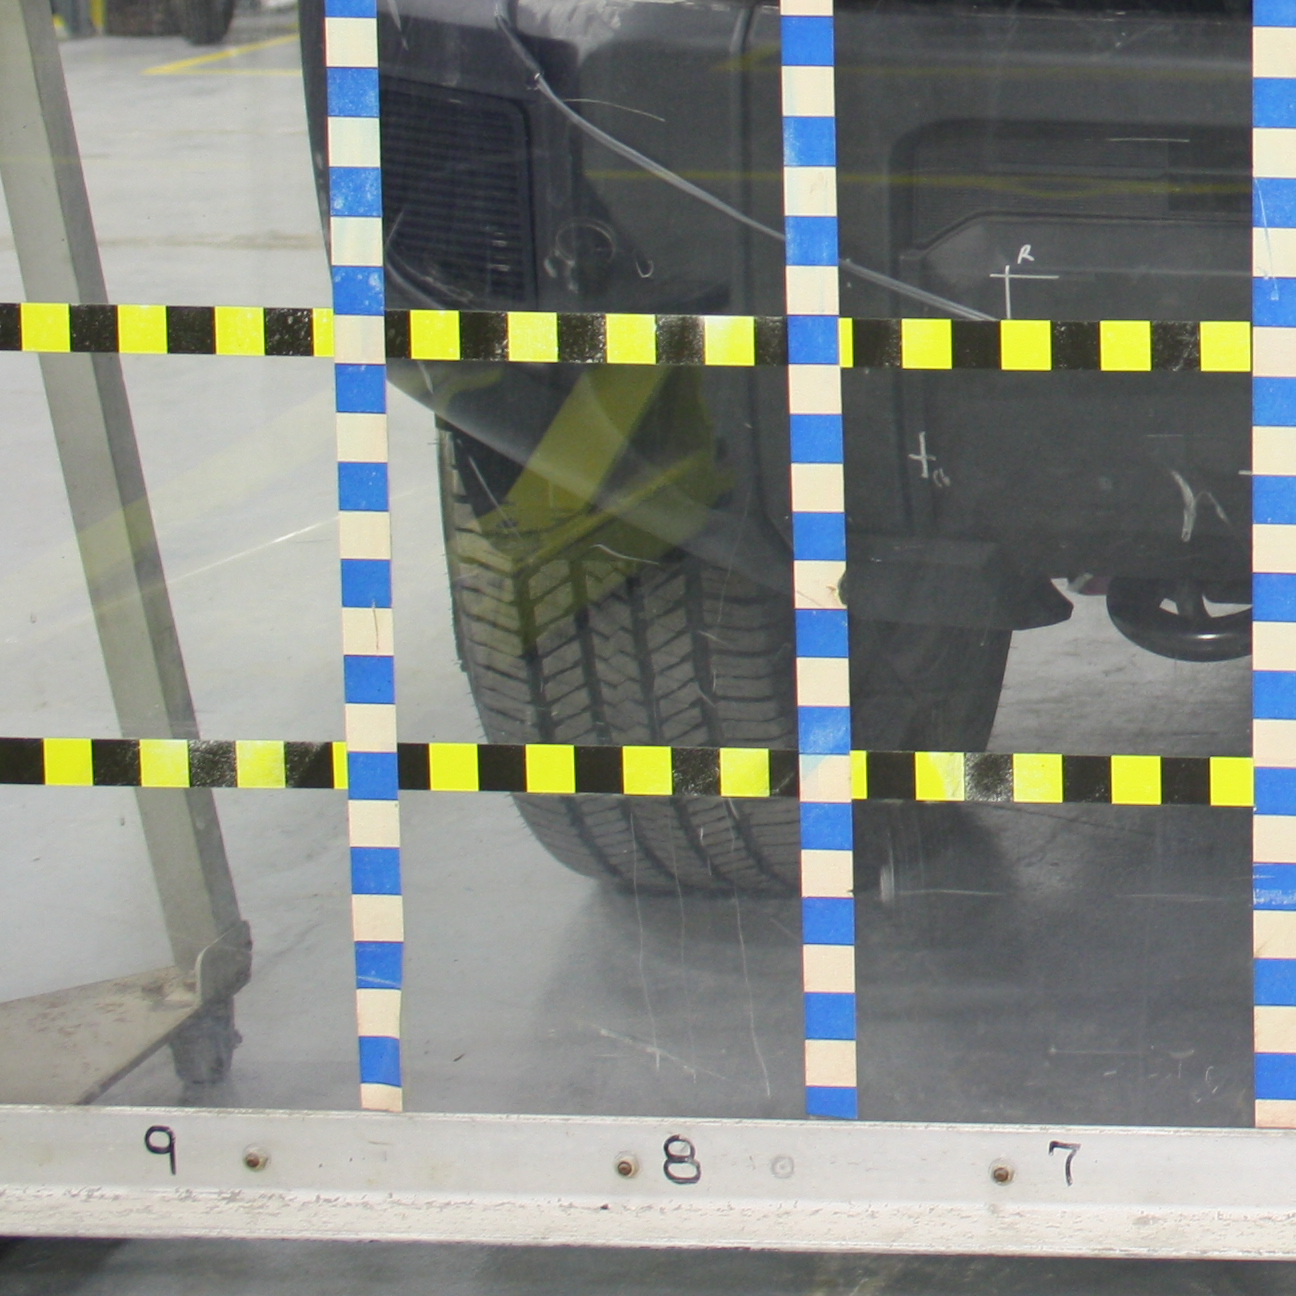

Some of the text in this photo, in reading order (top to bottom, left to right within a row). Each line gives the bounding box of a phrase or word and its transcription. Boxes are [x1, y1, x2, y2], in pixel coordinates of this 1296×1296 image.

[1017, 244, 1035, 264] R
[145, 1126, 177, 1176] 9
[663, 1135, 702, 1185] 8
[1048, 1141, 1082, 1186] 7
